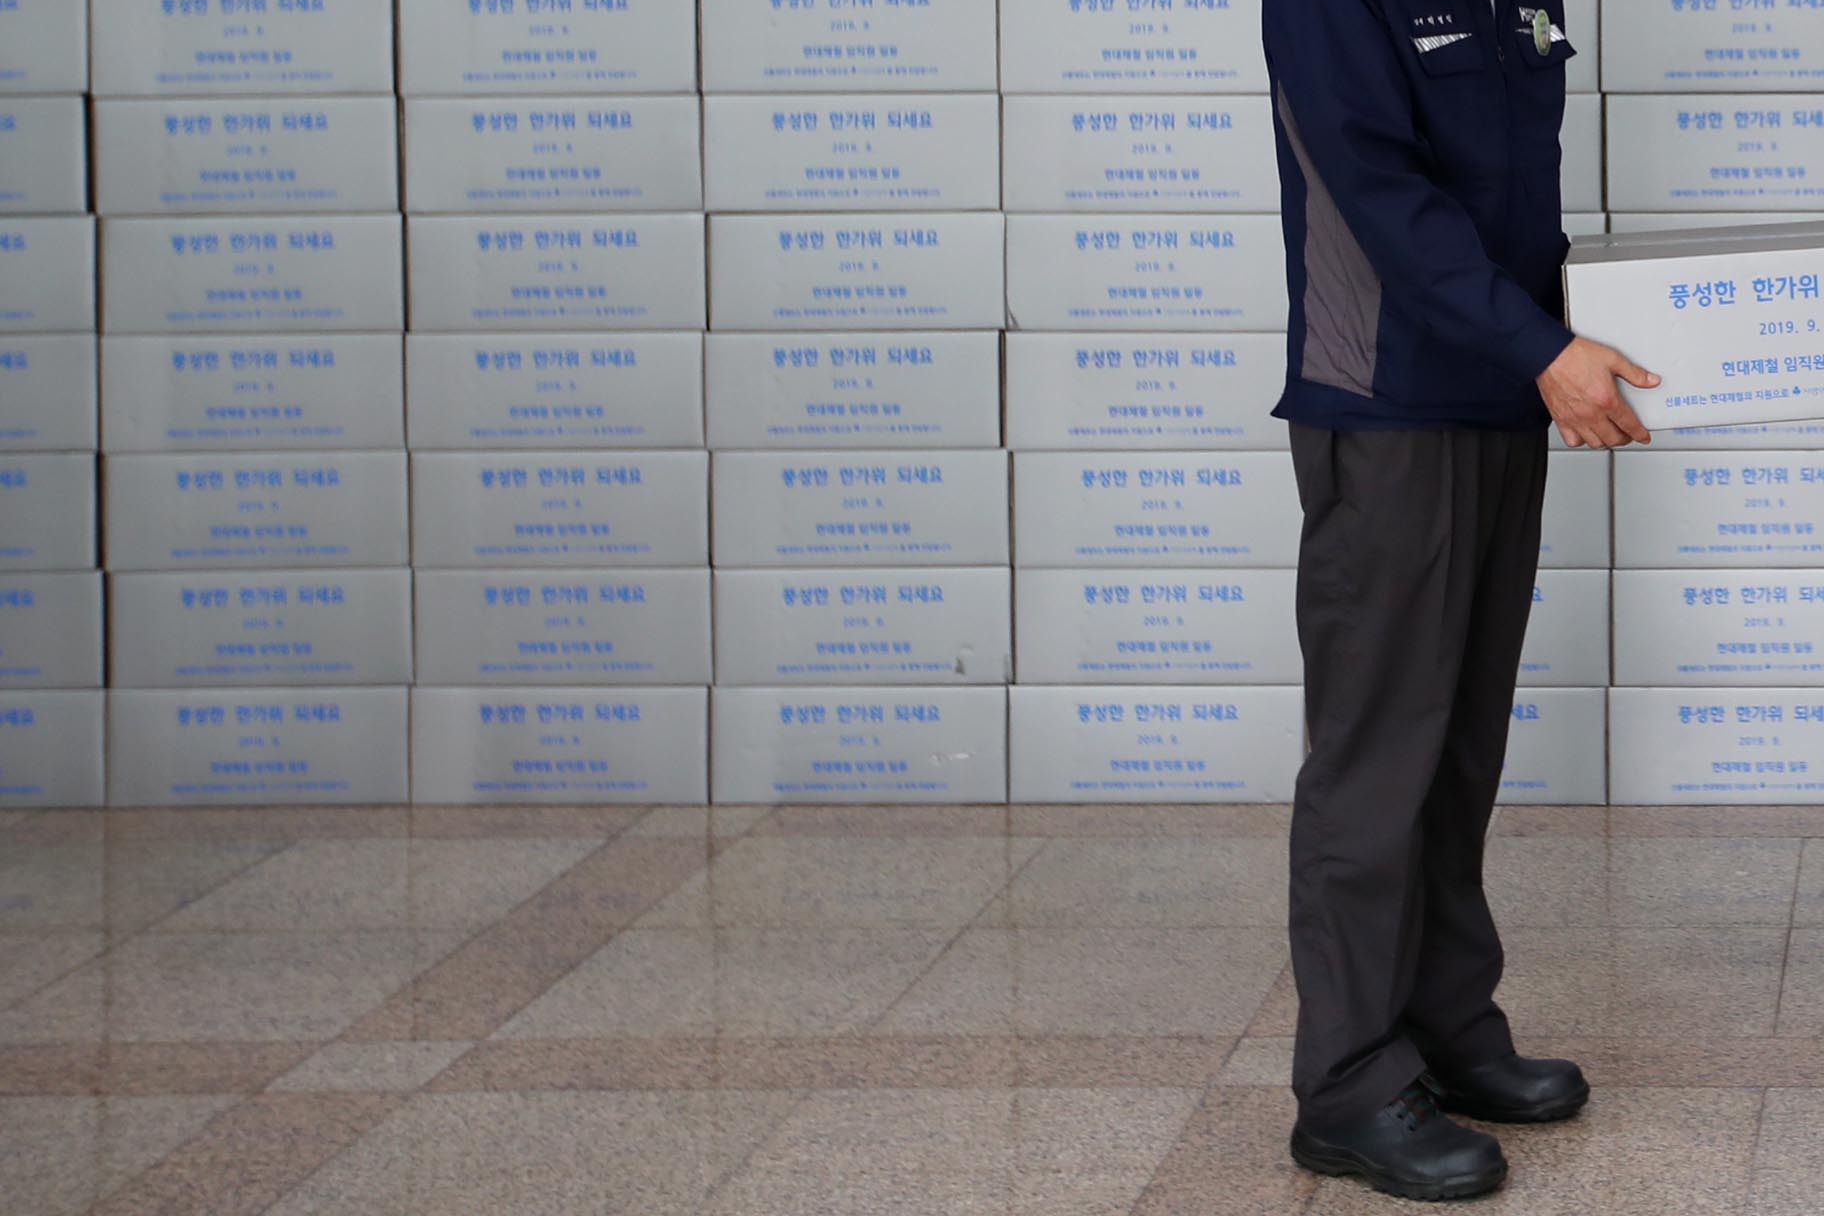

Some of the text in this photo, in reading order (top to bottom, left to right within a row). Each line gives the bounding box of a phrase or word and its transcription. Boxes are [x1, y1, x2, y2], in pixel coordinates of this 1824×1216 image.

[1072, 112, 1232, 131] 풍성한 한가위 되세요
[1669, 280, 1736, 309] 풍성한
[1752, 274, 1819, 302] 한가위
[1760, 319, 1820, 335] 2019. 9.
[1076, 350, 1236, 368] 풍성한 한가위 되세요
[1722, 358, 1778, 377] 현대제철
[1685, 468, 1730, 486] 풍성한
[1742, 468, 1788, 484] 한가위
[1078, 704, 1238, 722] 풍성한 한가위 되세요
[1679, 706, 1725, 724] 풍성한
[1736, 706, 1782, 723] 한가위
